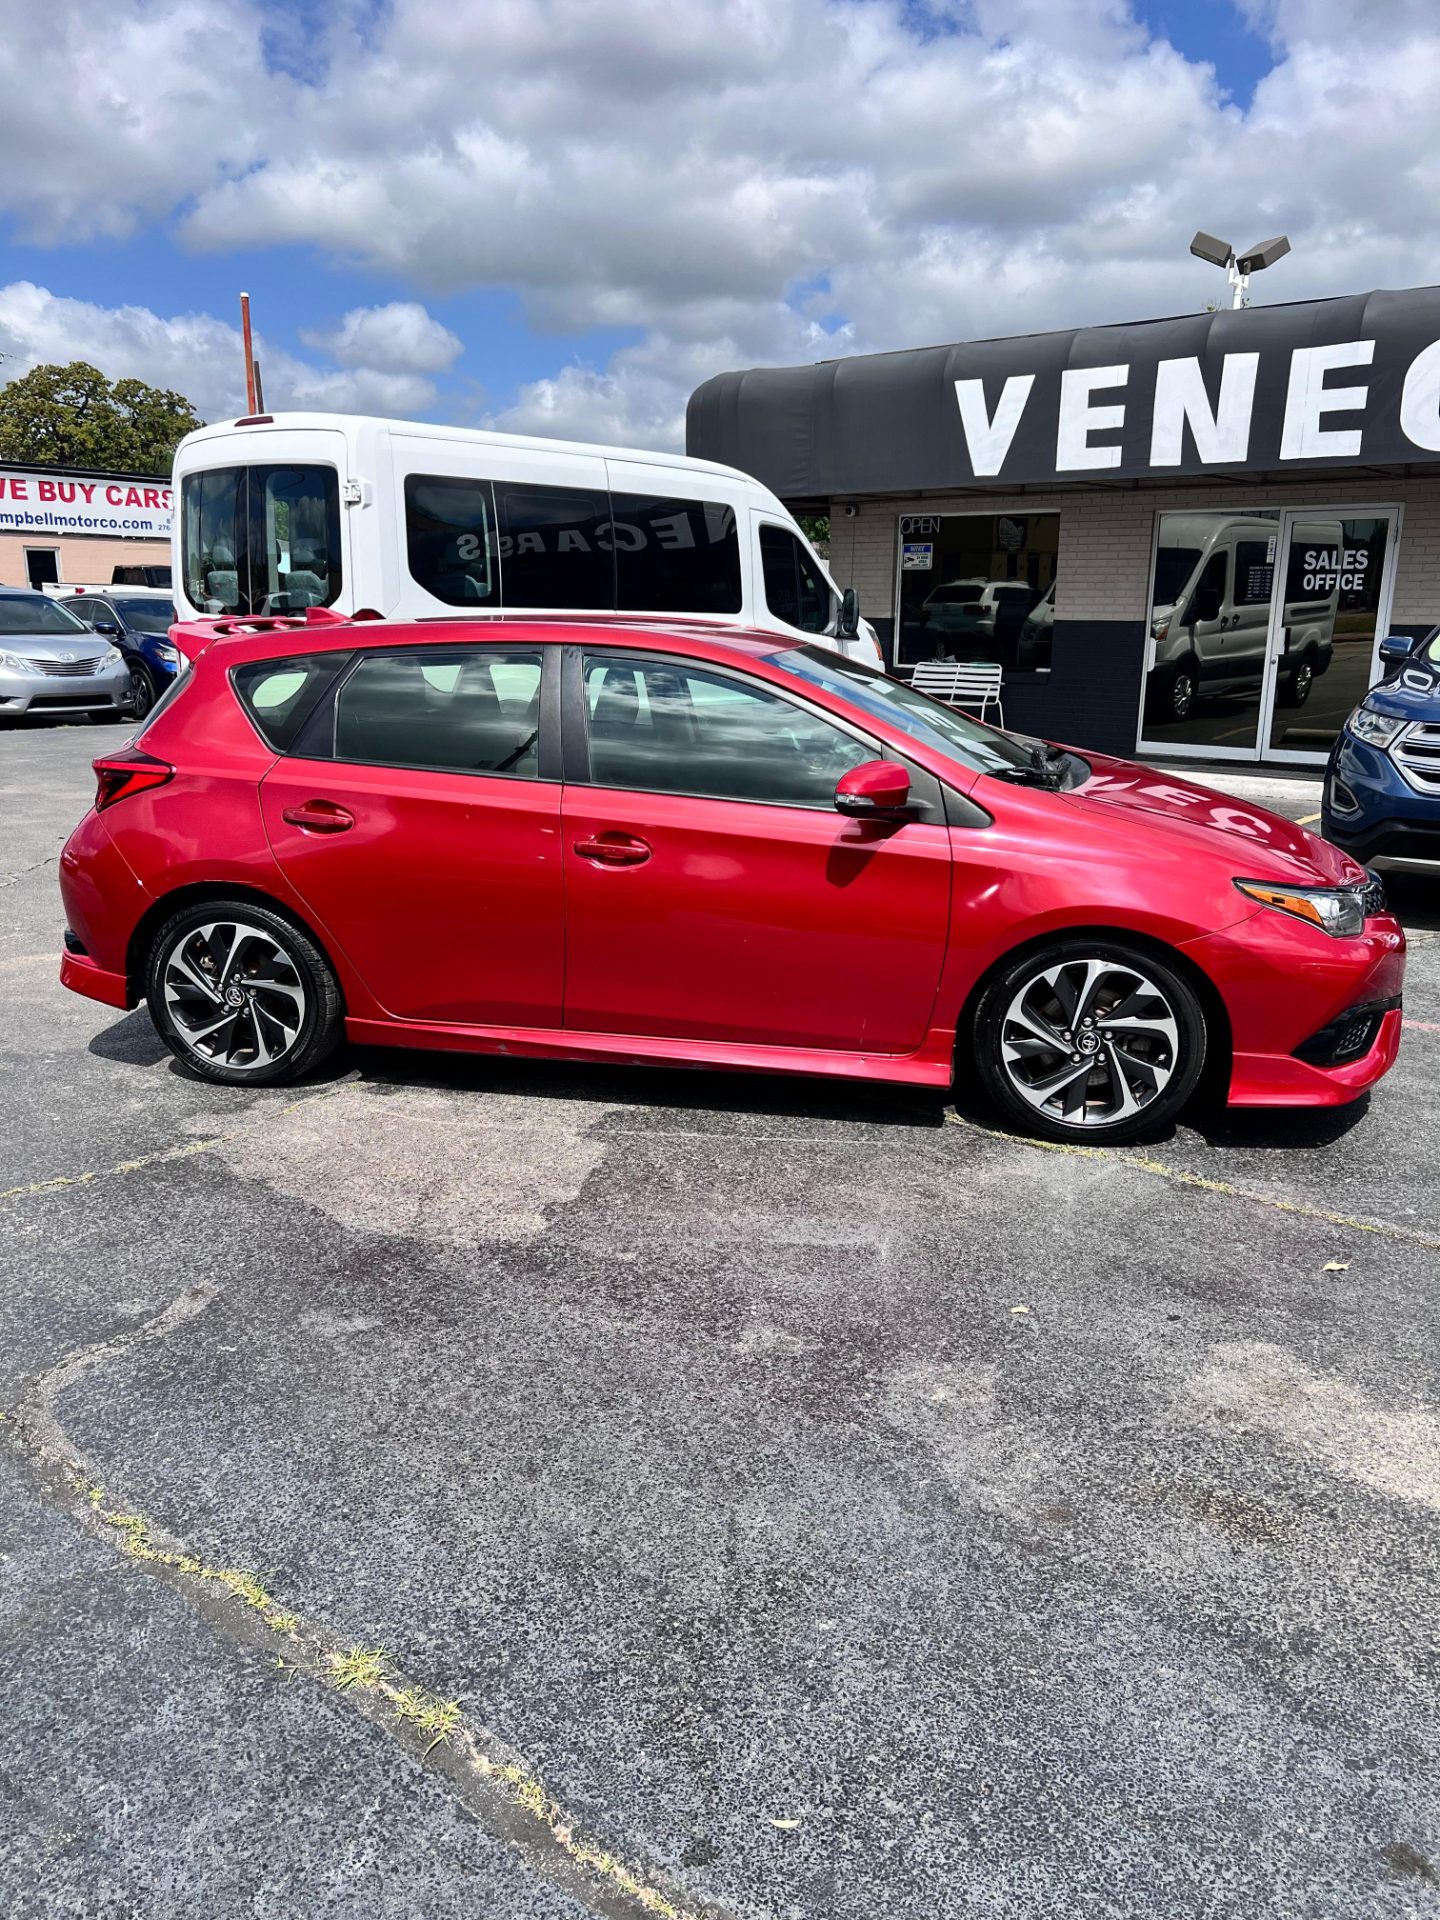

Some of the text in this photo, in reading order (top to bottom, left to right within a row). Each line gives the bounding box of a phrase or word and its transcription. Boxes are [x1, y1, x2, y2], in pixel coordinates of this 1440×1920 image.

[38, 480, 96, 504] BUY
[105, 485, 174, 509] CARS
[901, 517, 940, 534] OPEN
[1303, 550, 1368, 571] SALES
[1303, 573, 1365, 590] OFFICE
